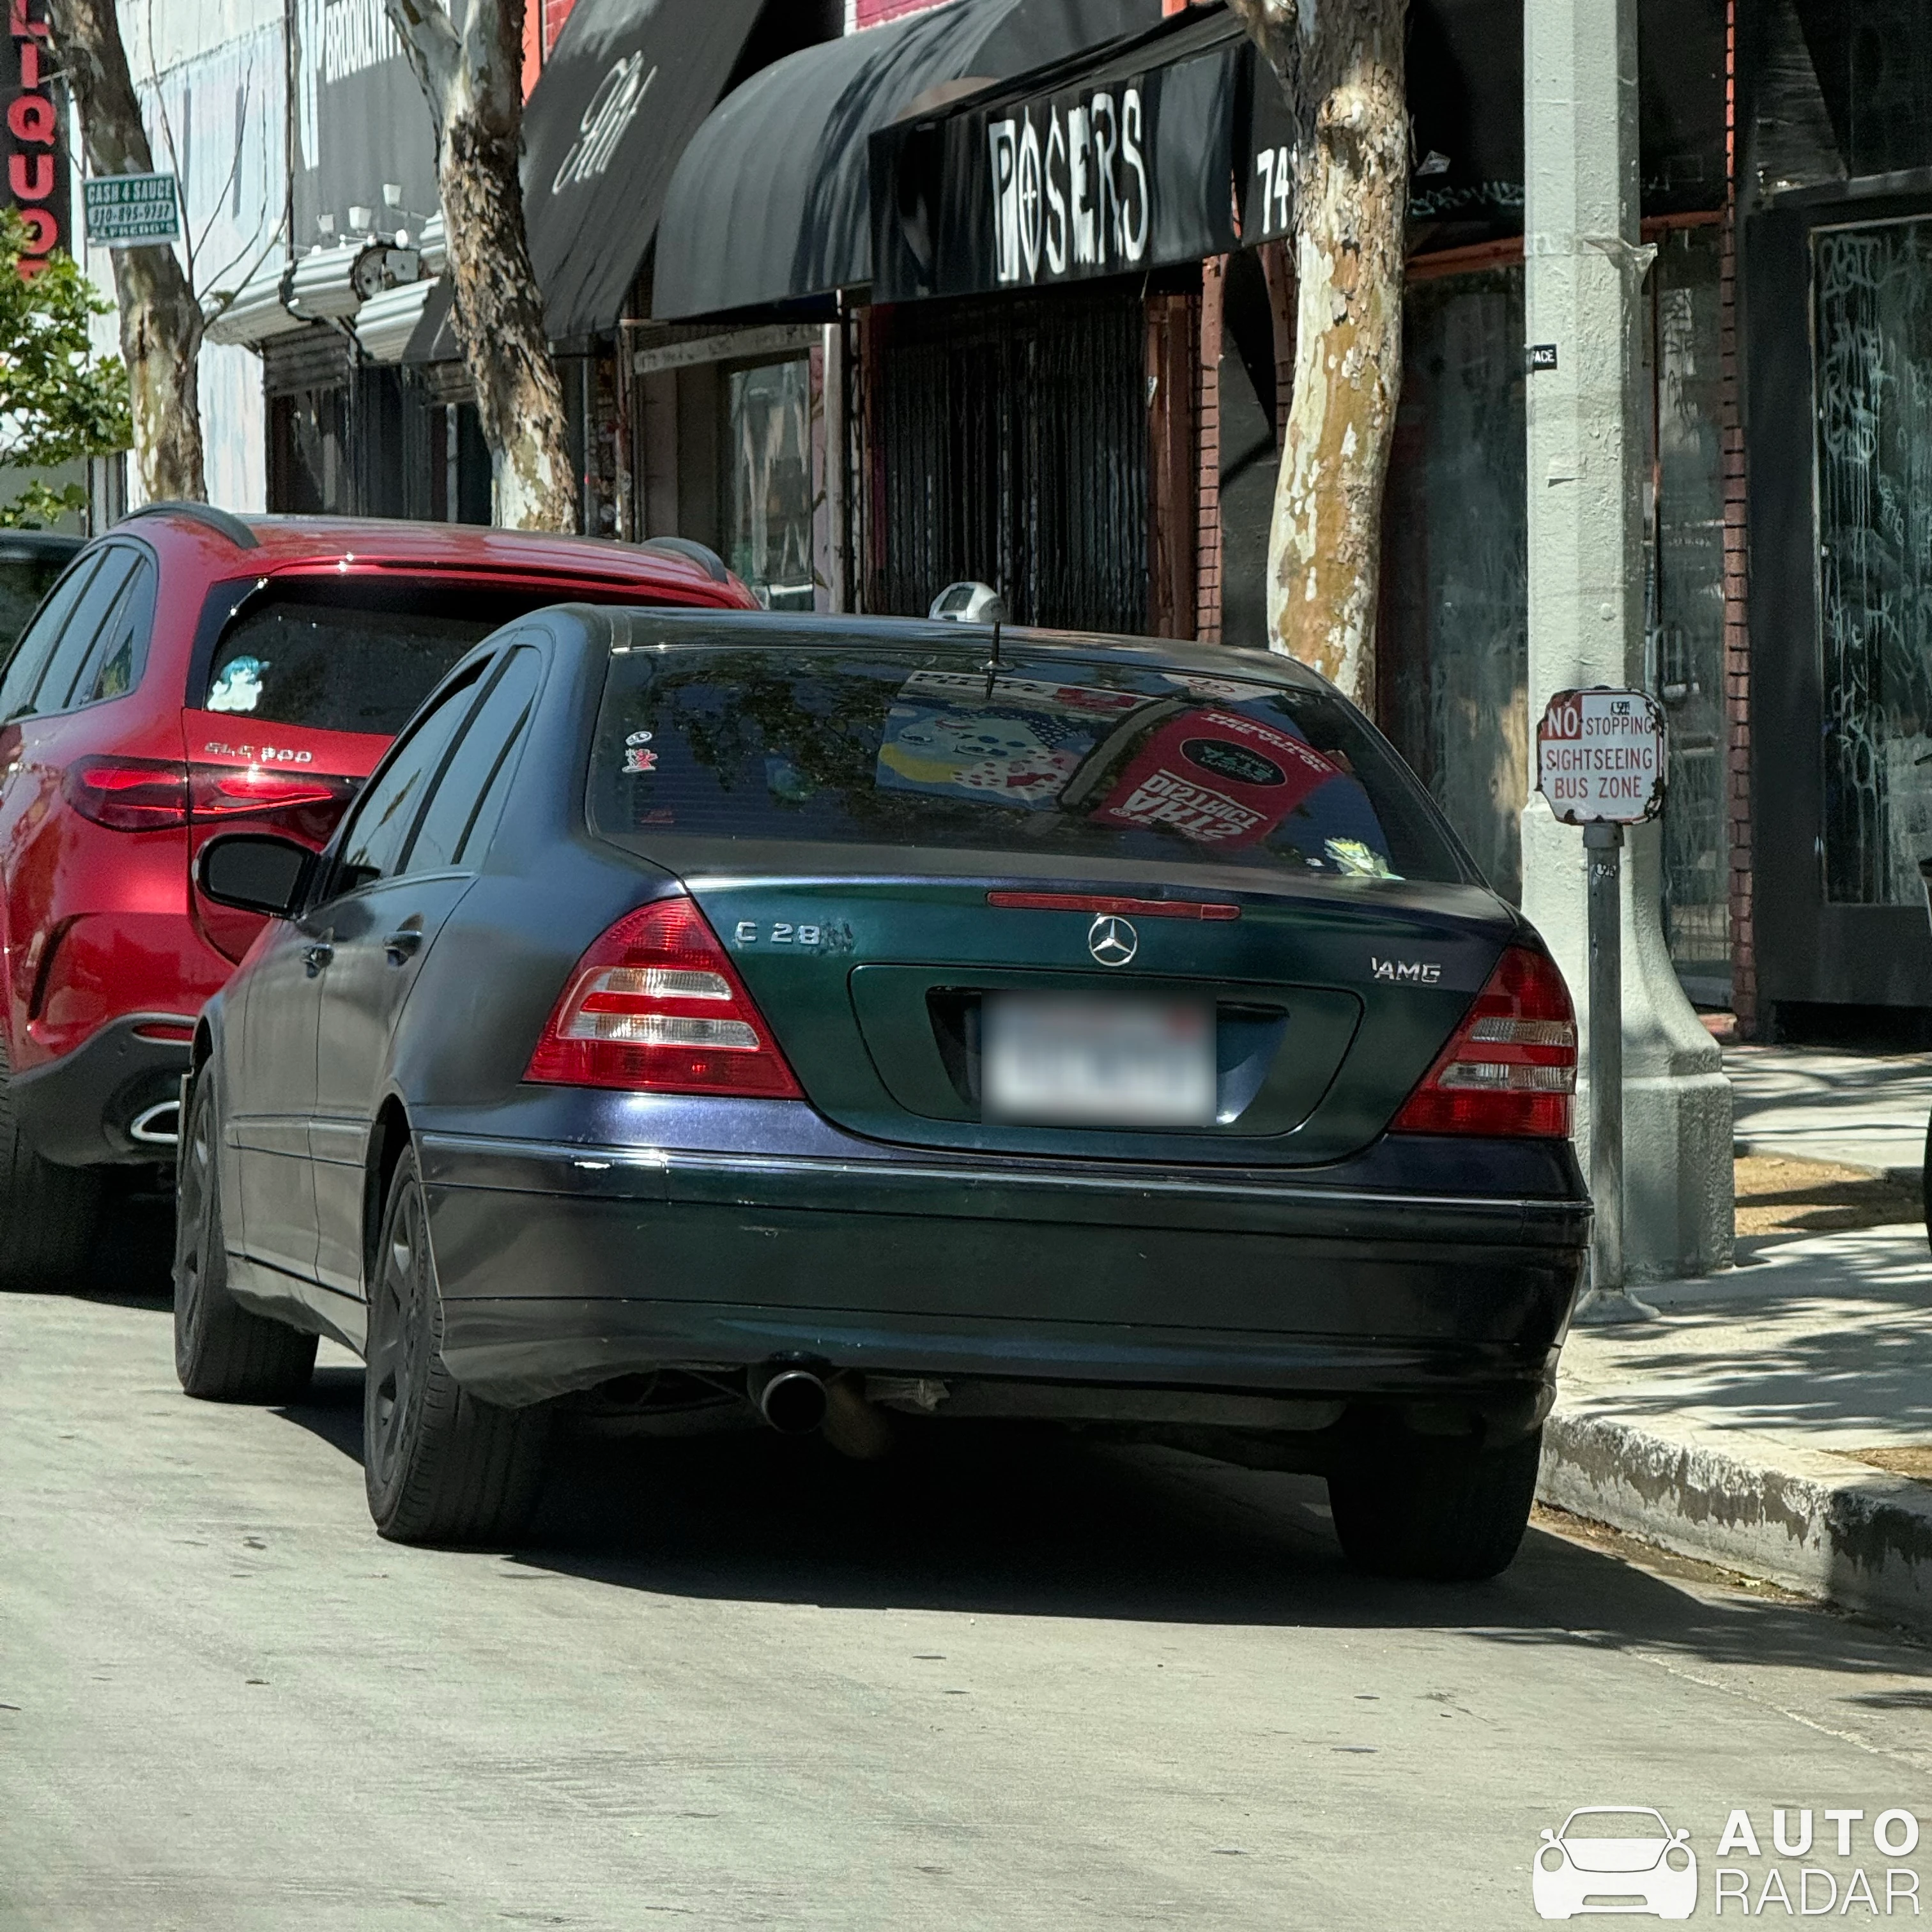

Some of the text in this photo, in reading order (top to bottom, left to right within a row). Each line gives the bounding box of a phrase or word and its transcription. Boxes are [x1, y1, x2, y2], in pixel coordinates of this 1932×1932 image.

[989, 88, 1149, 284] POSERS
[1549, 707, 1653, 737] NO STOPPING
[1546, 747, 1653, 771] SIGHTSEEING
[1555, 775, 1643, 799] BUS ZONE
[735, 921, 758, 942] C
